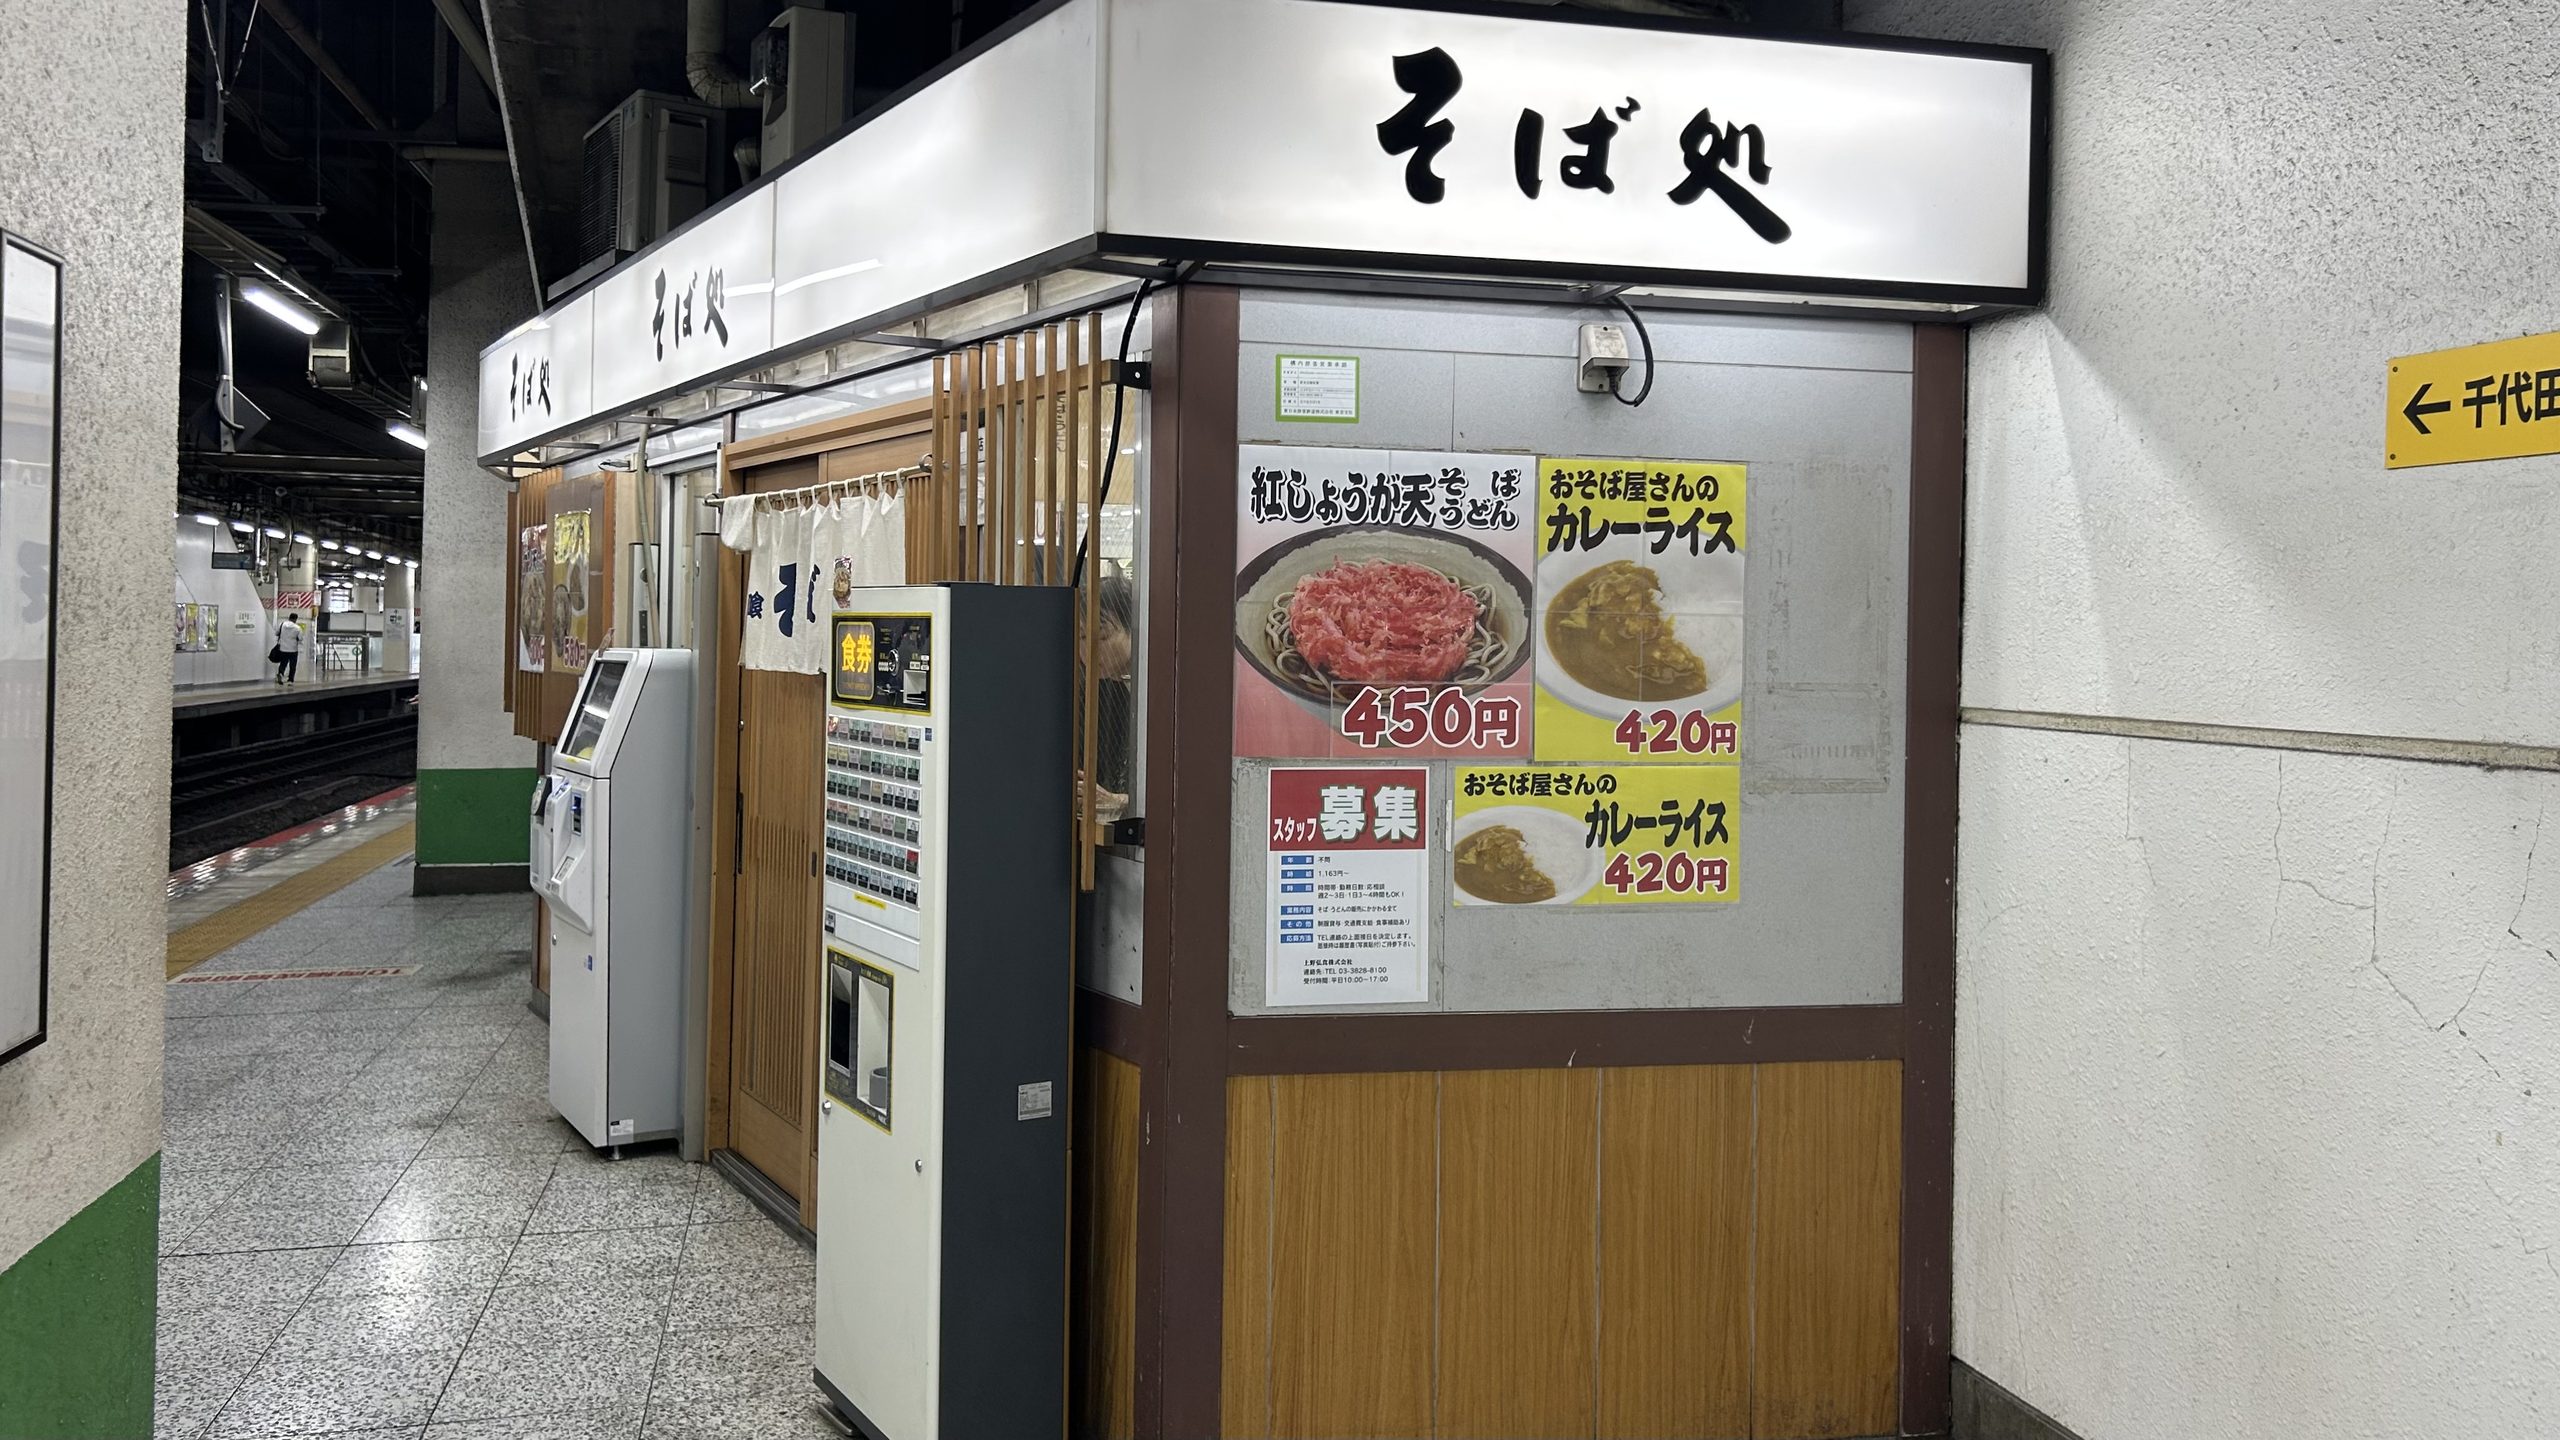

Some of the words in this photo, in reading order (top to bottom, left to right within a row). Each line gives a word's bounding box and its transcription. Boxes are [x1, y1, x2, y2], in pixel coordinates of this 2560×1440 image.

[1376, 46, 1792, 244] そば処
[652, 265, 728, 362] そば処
[510, 353, 551, 423] そば処
[2462, 368, 2560, 429] 千代田
[1251, 466, 1435, 526] 紅しょうが天
[1550, 468, 1719, 503] おそば屋さんの
[1440, 498, 1519, 530] うどん
[1546, 502, 1736, 557] カレーライス
[841, 633, 872, 674] 食券
[1342, 687, 1520, 748] 450円
[1615, 709, 1738, 755] 420円
[1464, 773, 1617, 796] おそば屋さんの
[1273, 817, 1317, 842] スタッフ
[1320, 786, 1418, 840] 募集
[1585, 799, 1729, 848] カレーライス
[1604, 851, 1729, 895] 420円
